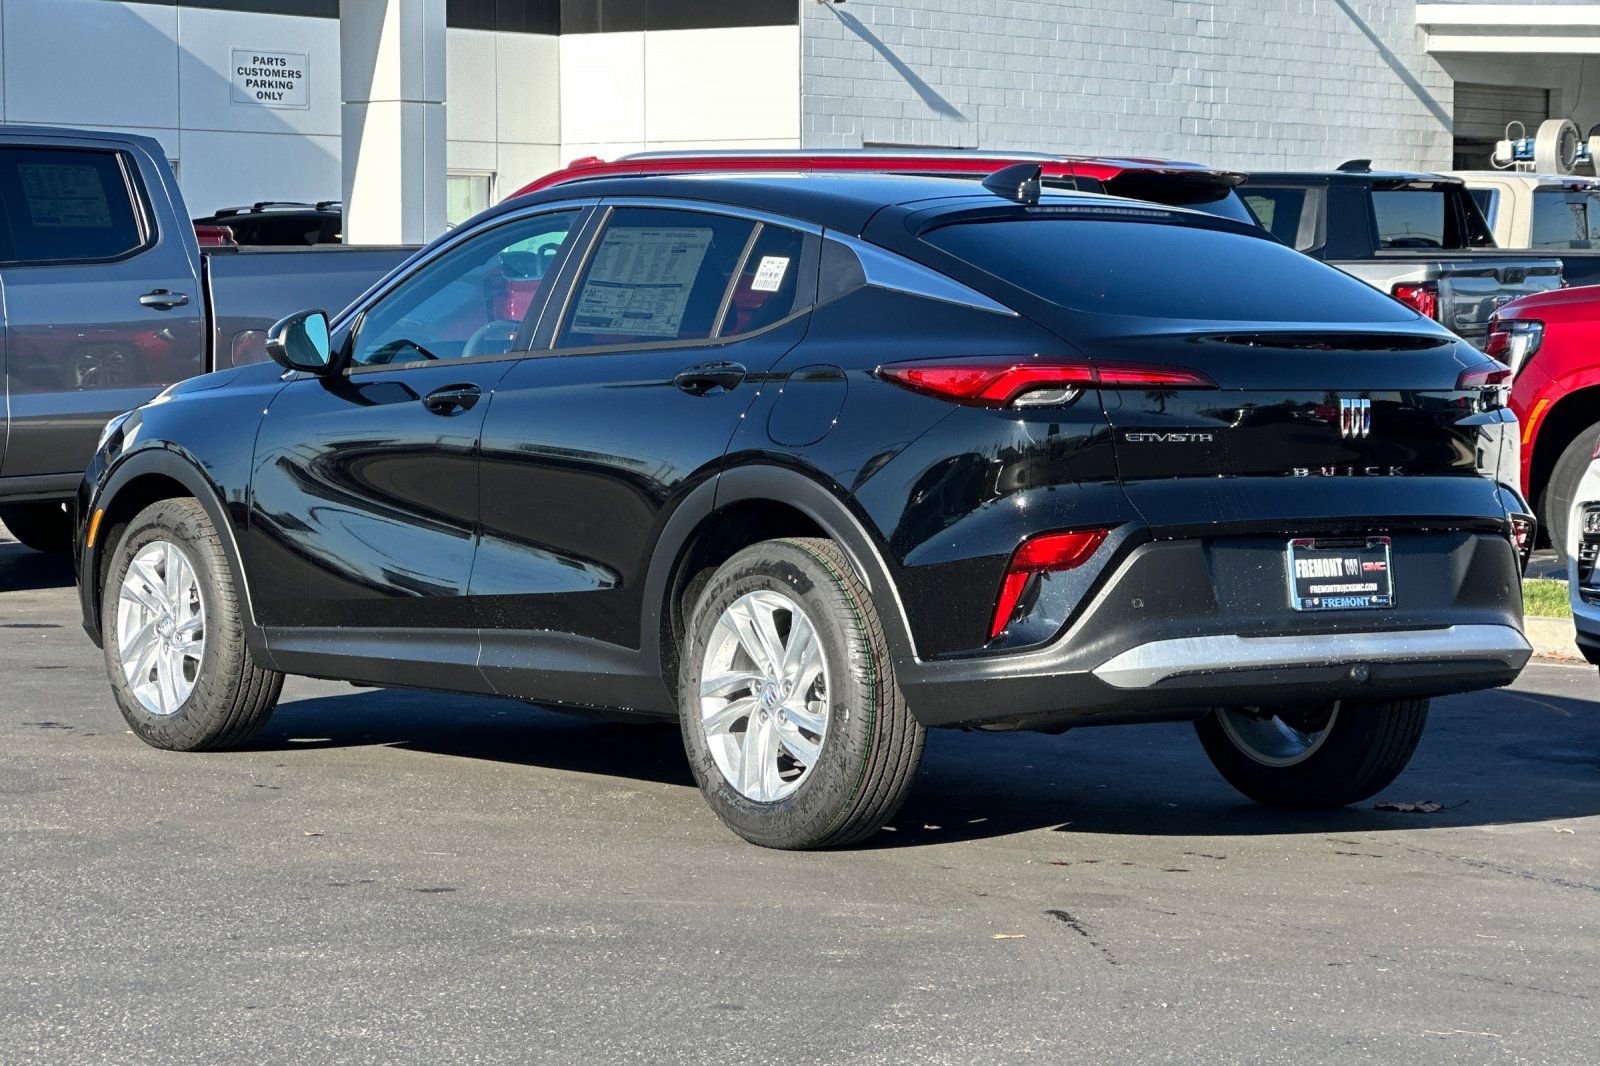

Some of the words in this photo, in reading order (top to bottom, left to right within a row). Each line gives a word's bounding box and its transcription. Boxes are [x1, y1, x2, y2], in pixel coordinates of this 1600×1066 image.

[253, 56, 287, 67] PARTS
[237, 66, 302, 79] CUSTOMERS
[246, 79, 294, 90] PARKING
[256, 91, 283, 101] ONLY
[1125, 433, 1213, 442] ENVISTA
[1293, 466, 1404, 478] BUICK
[1295, 558, 1343, 578] FREMONT
[1321, 597, 1370, 608] FREMONT
